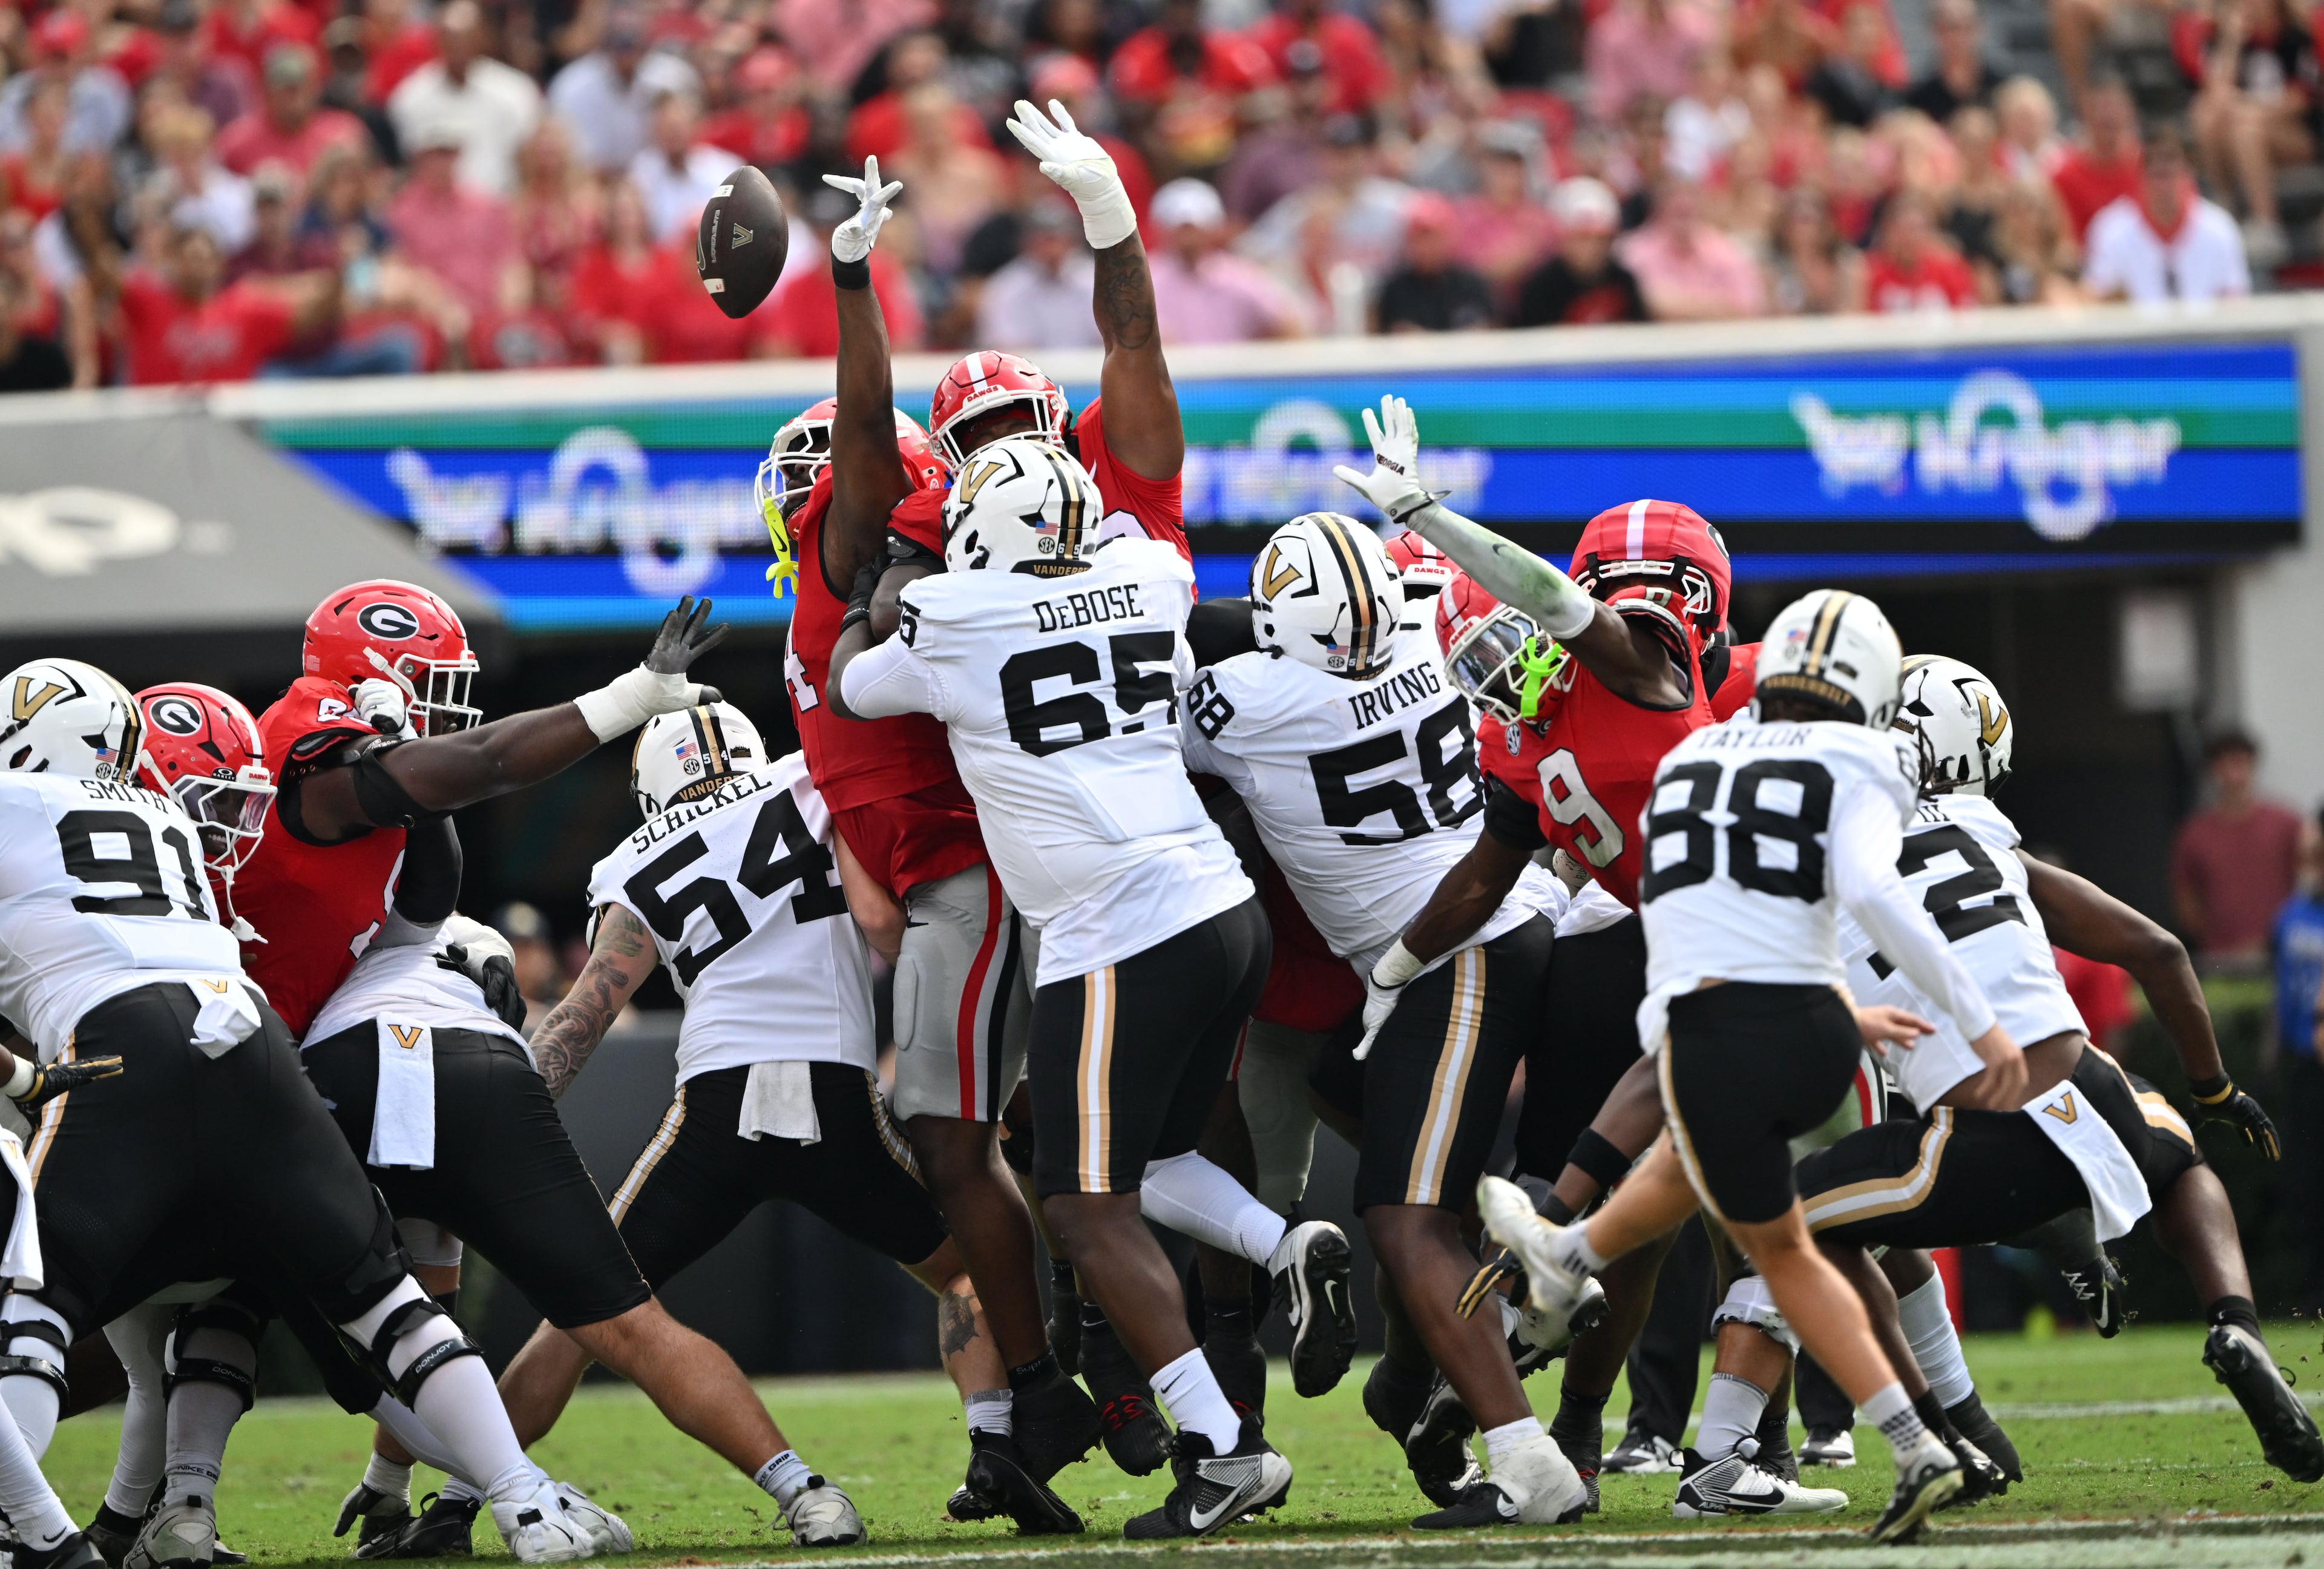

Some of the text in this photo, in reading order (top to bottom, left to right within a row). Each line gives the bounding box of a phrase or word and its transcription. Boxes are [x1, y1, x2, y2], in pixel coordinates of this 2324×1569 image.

[731, 222, 754, 249] V
[967, 386, 999, 402] DAWGS
[1377, 453, 1405, 475] GEORGIA
[960, 460, 1007, 504] V
[1039, 539, 1054, 553] SEC
[1262, 542, 1303, 601] V
[1414, 567, 1445, 575] DAWGS
[358, 602, 419, 641] G
[1452, 622, 1473, 645] DAWGS
[1330, 658, 1344, 666] SEC
[13, 676, 69, 722] V
[999, 631, 1178, 758] 65
[1348, 662, 1440, 730] IRVING
[149, 697, 202, 736] G
[1971, 687, 2009, 746] V
[1699, 728, 1811, 748] TAYLOR
[97, 765, 111, 778] SEC
[685, 760, 699, 774] SEC
[702, 753, 711, 764] 5
[721, 750, 729, 760] 4
[1308, 696, 1486, 846] 58
[80, 780, 168, 814] SMITH
[1537, 748, 1624, 867] 9
[632, 773, 773, 855] SCHICKEL
[1641, 760, 1835, 903] 88
[56, 810, 213, 922] 91
[623, 788, 849, 988] 54
[387, 1024, 424, 1049] V
[2042, 1091, 2078, 1125] V
[415, 1342, 451, 1373] DONJOY
[212, 1366, 251, 1384] DONJOY
[177, 1465, 204, 1474] NIKE
[768, 1453, 789, 1471] GRIP
